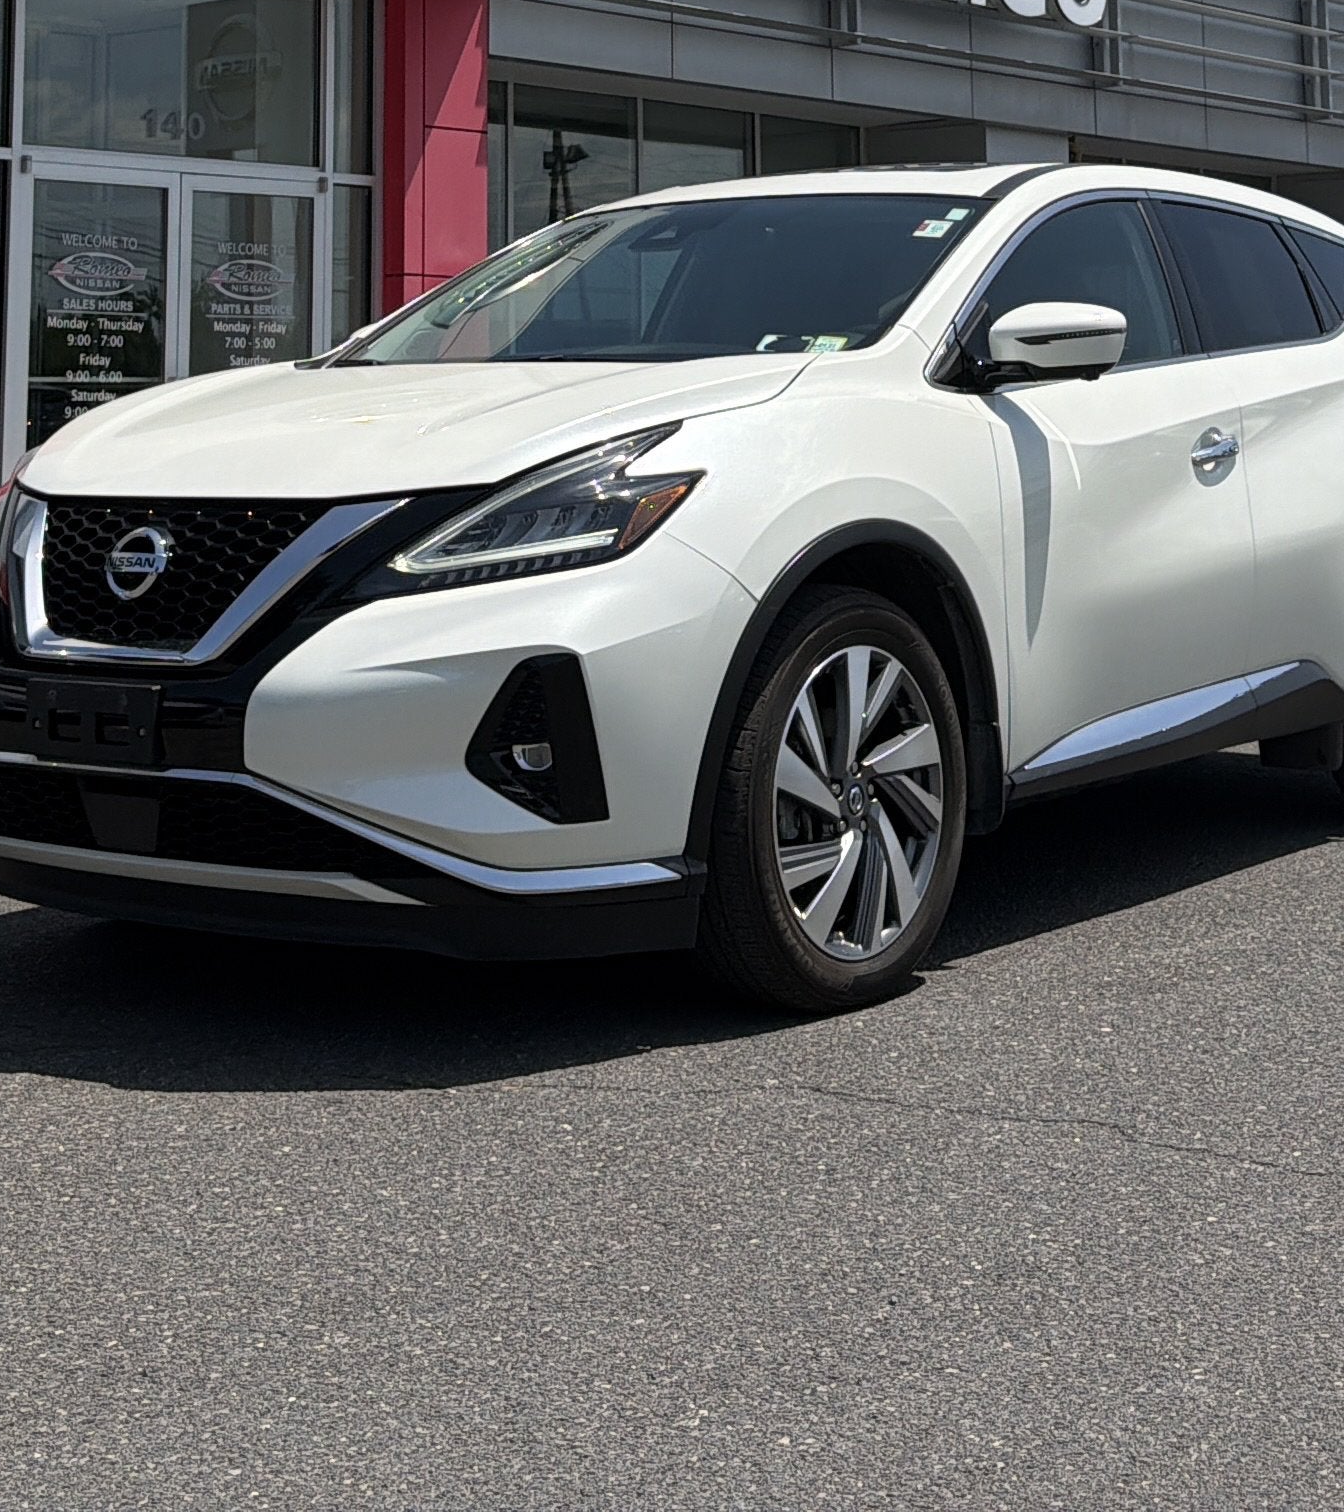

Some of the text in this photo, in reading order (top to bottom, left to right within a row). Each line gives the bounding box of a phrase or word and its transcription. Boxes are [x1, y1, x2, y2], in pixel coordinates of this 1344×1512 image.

[140, 108, 206, 140] 140
[61, 233, 138, 249] WELCOME TO
[217, 242, 287, 257] WELCOME TO
[68, 255, 133, 277] Romeo
[76, 277, 121, 289] NISSAN
[231, 284, 271, 294] NISSAN
[63, 298, 134, 312] SALES HOURS
[211, 303, 293, 316] PARTS & SERVICE
[47, 316, 89, 332] Monday
[97, 317, 145, 335] Thursday
[213, 320, 251, 335] Monday
[259, 321, 287, 335] Friday
[67, 334, 91, 346] 9:00
[100, 335, 124, 347] 7:00
[225, 336, 247, 348] 7:00
[254, 337, 276, 349] 5:00
[79, 353, 112, 368] Friday
[66, 370, 90, 382] 9:00
[99, 370, 123, 383] 6:00
[108, 556, 156, 569] NISSAN
